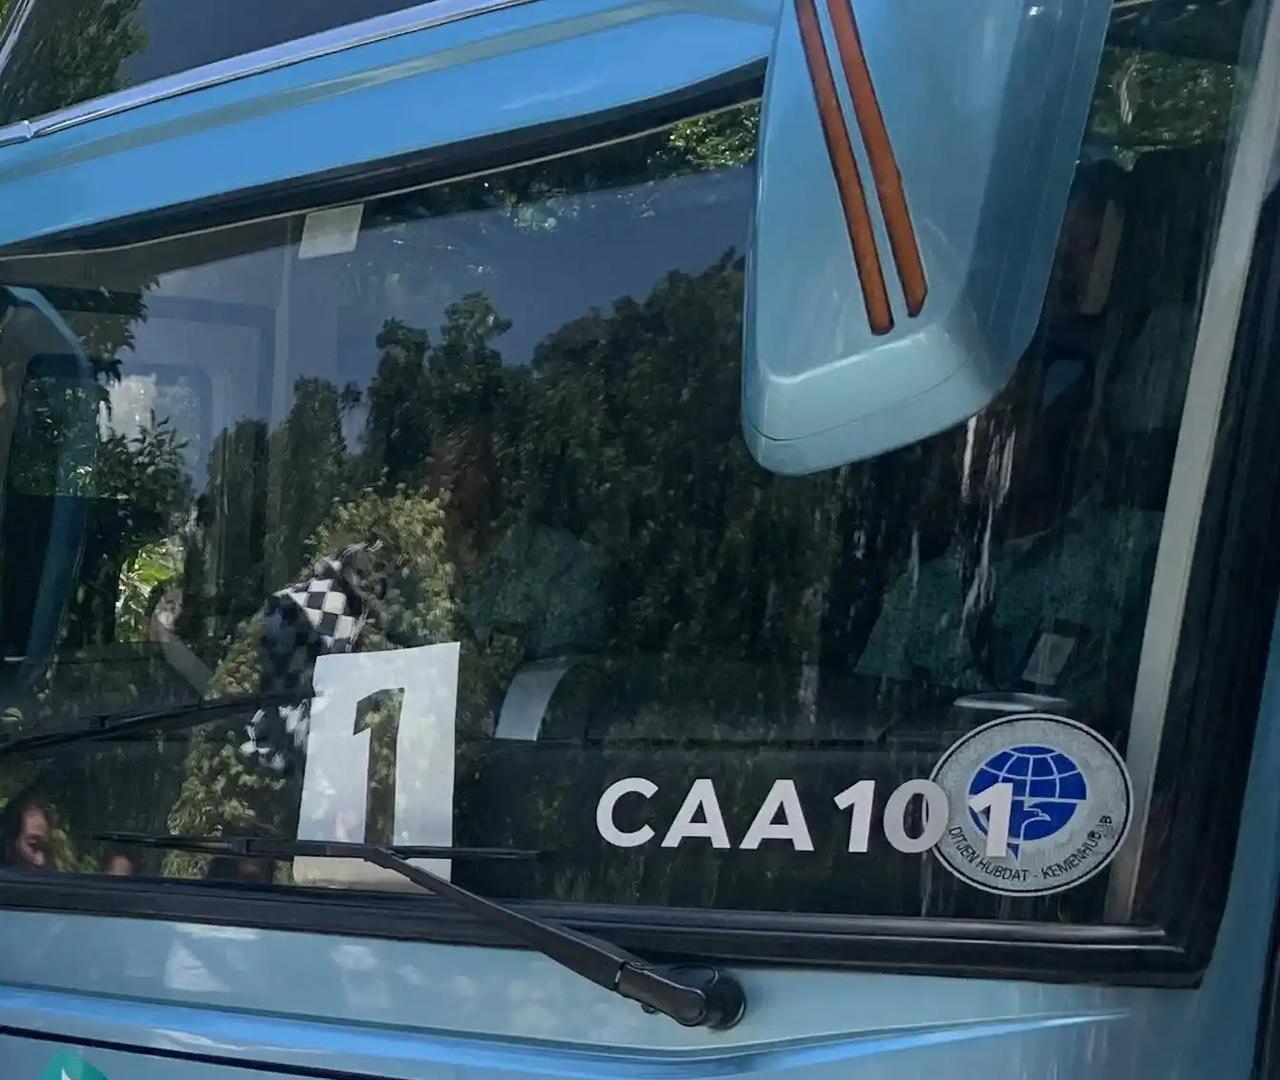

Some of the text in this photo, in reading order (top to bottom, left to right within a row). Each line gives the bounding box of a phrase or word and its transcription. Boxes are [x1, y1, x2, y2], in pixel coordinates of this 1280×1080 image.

[353, 687, 405, 848] 1
[596, 777, 1014, 857] CAA 101
[948, 825, 979, 865] DITJEN
[975, 857, 1031, 884] HUBDAT
